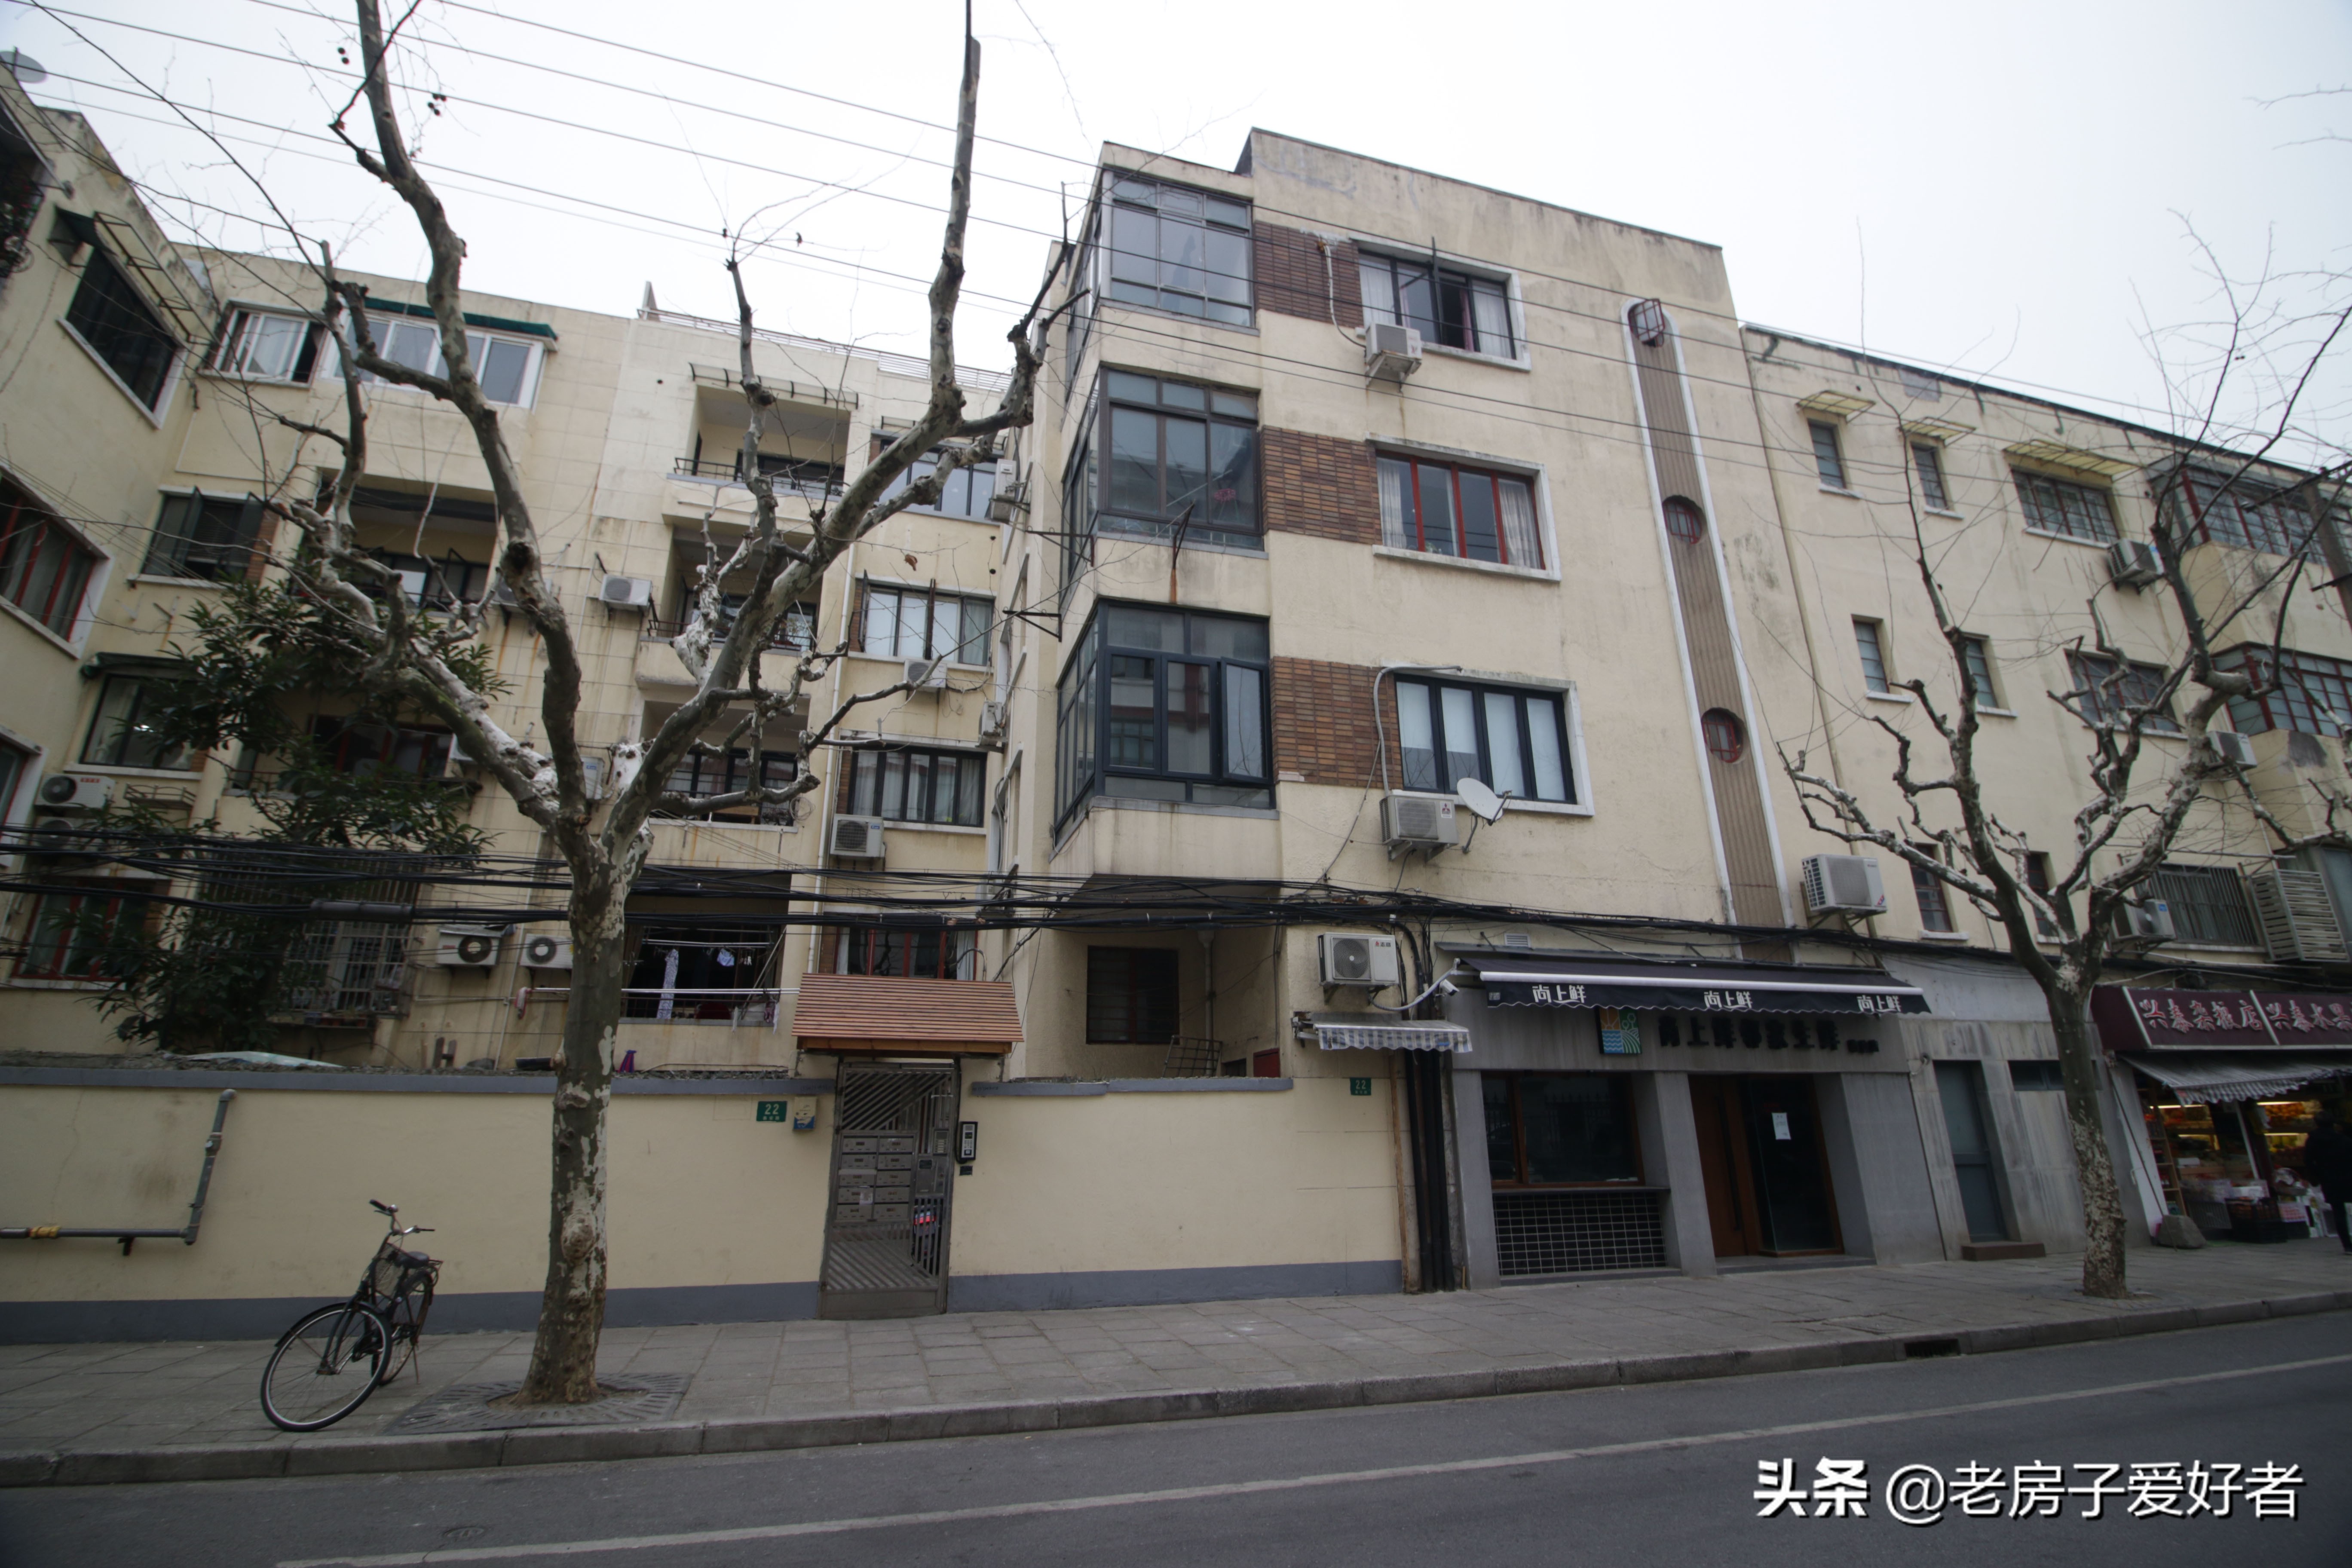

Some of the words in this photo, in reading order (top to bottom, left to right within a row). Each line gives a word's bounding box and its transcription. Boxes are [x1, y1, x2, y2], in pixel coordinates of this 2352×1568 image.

[1532, 984, 1586, 1004] 尚上鲜
[1703, 990, 1753, 1009] 尚上鲜
[1856, 995, 1902, 1012] 尚上鲜
[2139, 998, 2263, 1034] 兴泰杂粮店
[2266, 999, 2352, 1034] 兴泰水果
[1355, 1079, 1366, 1090] 22
[764, 1103, 779, 1115] 22
